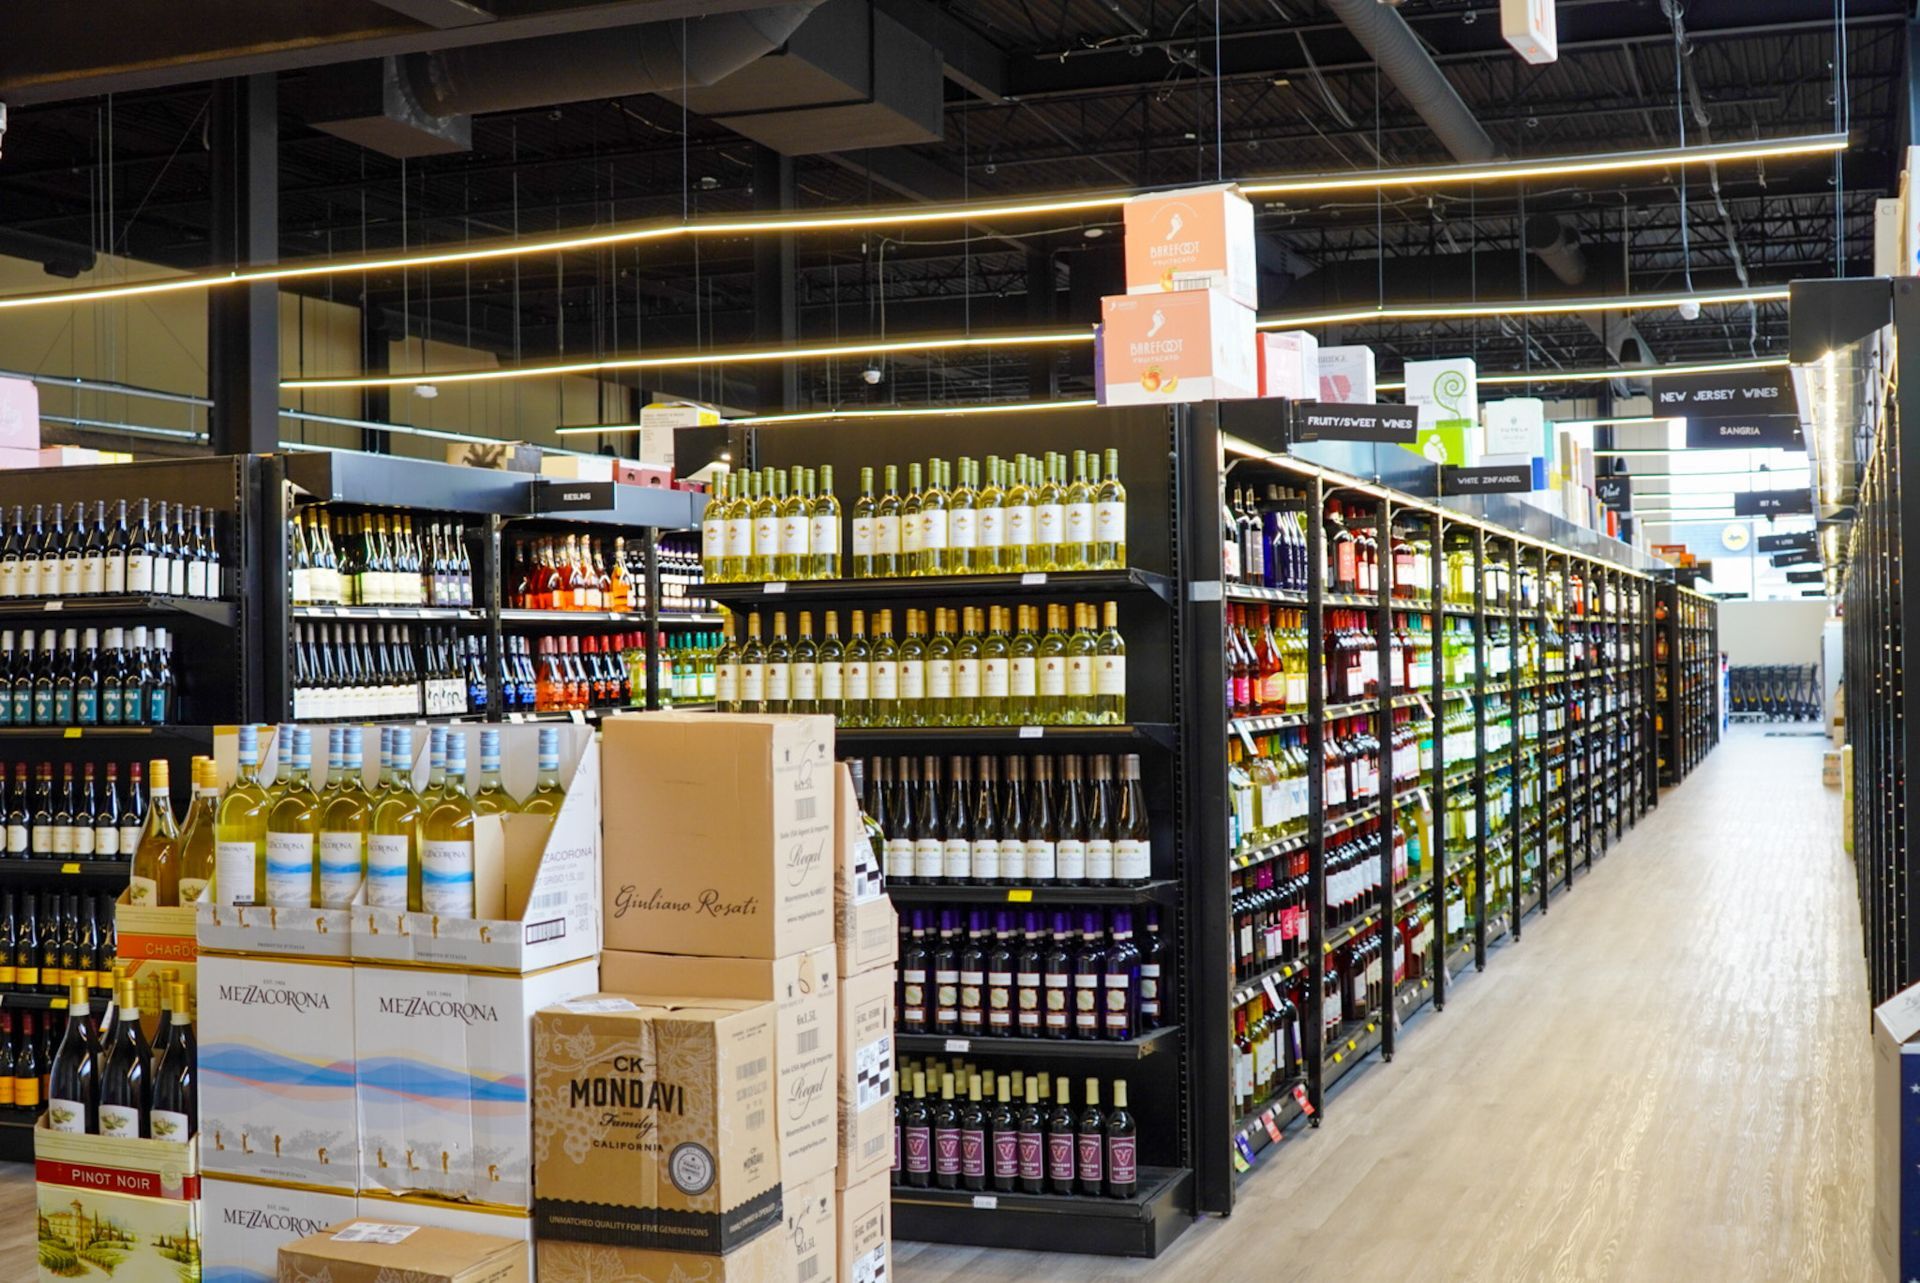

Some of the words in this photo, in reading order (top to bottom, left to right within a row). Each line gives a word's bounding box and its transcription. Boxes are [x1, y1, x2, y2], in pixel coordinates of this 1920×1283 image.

[1150, 241, 1200, 258] BAREFOOT
[1130, 339, 1183, 357] BAREFOOT
[1660, 392, 1687, 402] NEW
[1693, 389, 1736, 401] JERSEY
[1742, 387, 1778, 398] WINES
[1308, 416, 1377, 428] FRUITY/SWEET
[1382, 419, 1412, 429] WINES
[1720, 426, 1760, 435] SANGRIA
[1457, 476, 1479, 485] WHITE
[1482, 475, 1521, 484] ZINFANDEL
[614, 885, 691, 918] Giuliano
[696, 888, 759, 917] Rosati
[219, 985, 330, 1013] MEZZACORONA
[379, 997, 498, 1025] MEZZACORONA
[614, 1056, 644, 1073] CK
[570, 1078, 684, 1116] MONDAVI
[599, 1113, 657, 1139] Family
[593, 1140, 664, 1153] CALIFORNIA
[72, 1169, 112, 1185] PINOT
[116, 1176, 150, 1190] NOIR
[549, 1216, 594, 1228] UNMATCHED
[595, 1219, 625, 1232] QUALITY
[626, 1222, 642, 1233] FOR
[642, 1223, 658, 1234] FIVE
[658, 1226, 709, 1238] GENERATIONS
